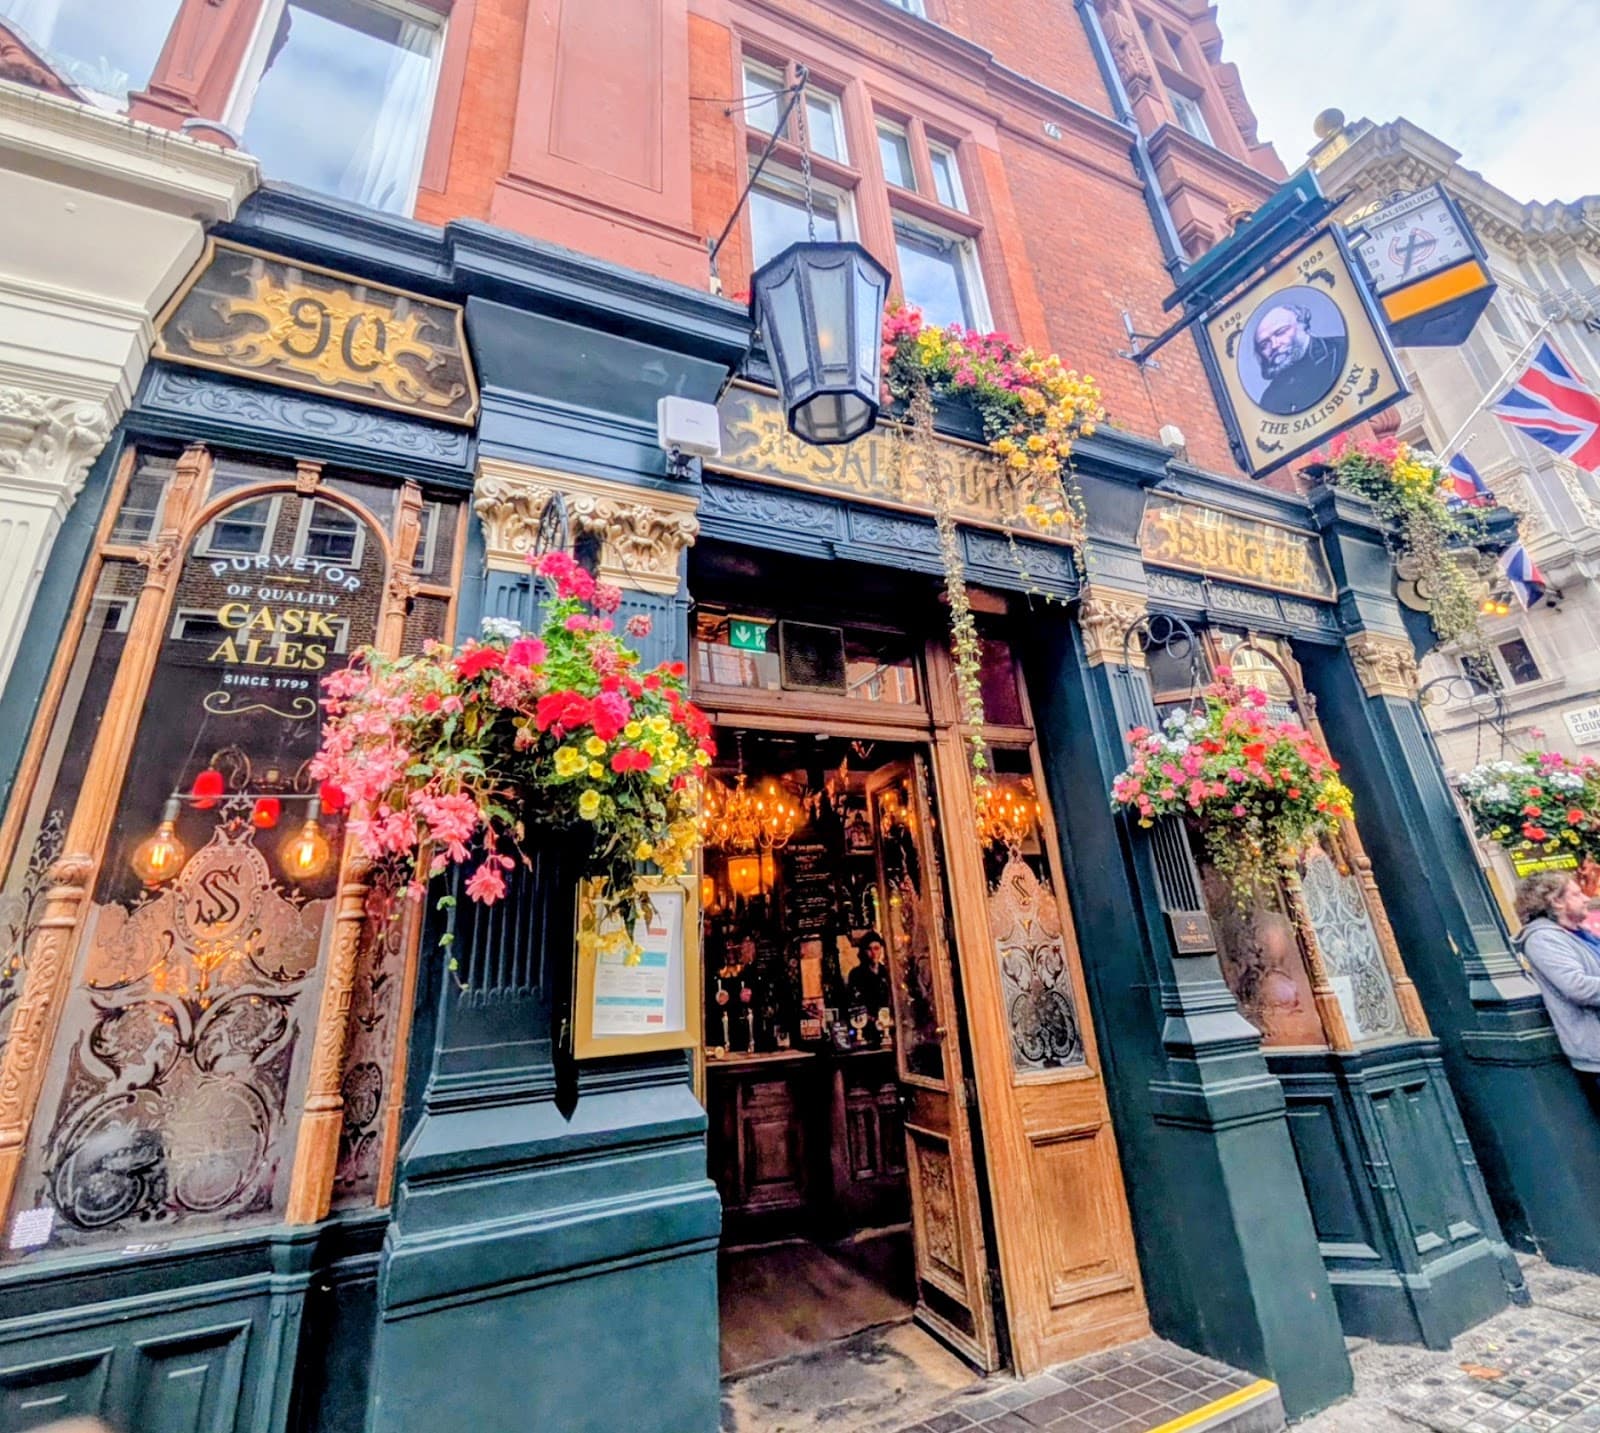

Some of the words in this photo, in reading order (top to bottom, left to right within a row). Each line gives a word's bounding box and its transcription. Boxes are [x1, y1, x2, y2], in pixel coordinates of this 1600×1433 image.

[281, 297, 386, 372] 90
[1260, 420, 1289, 435] THE
[1293, 363, 1364, 433] SALISBURY
[209, 554, 361, 593] PURVEYOR
[226, 584, 253, 597] OF
[257, 587, 340, 606] QUALITY
[217, 602, 339, 638] CASK
[207, 635, 328, 671] ALES
[223, 673, 270, 687] SINCE
[274, 678, 310, 690] 1799
